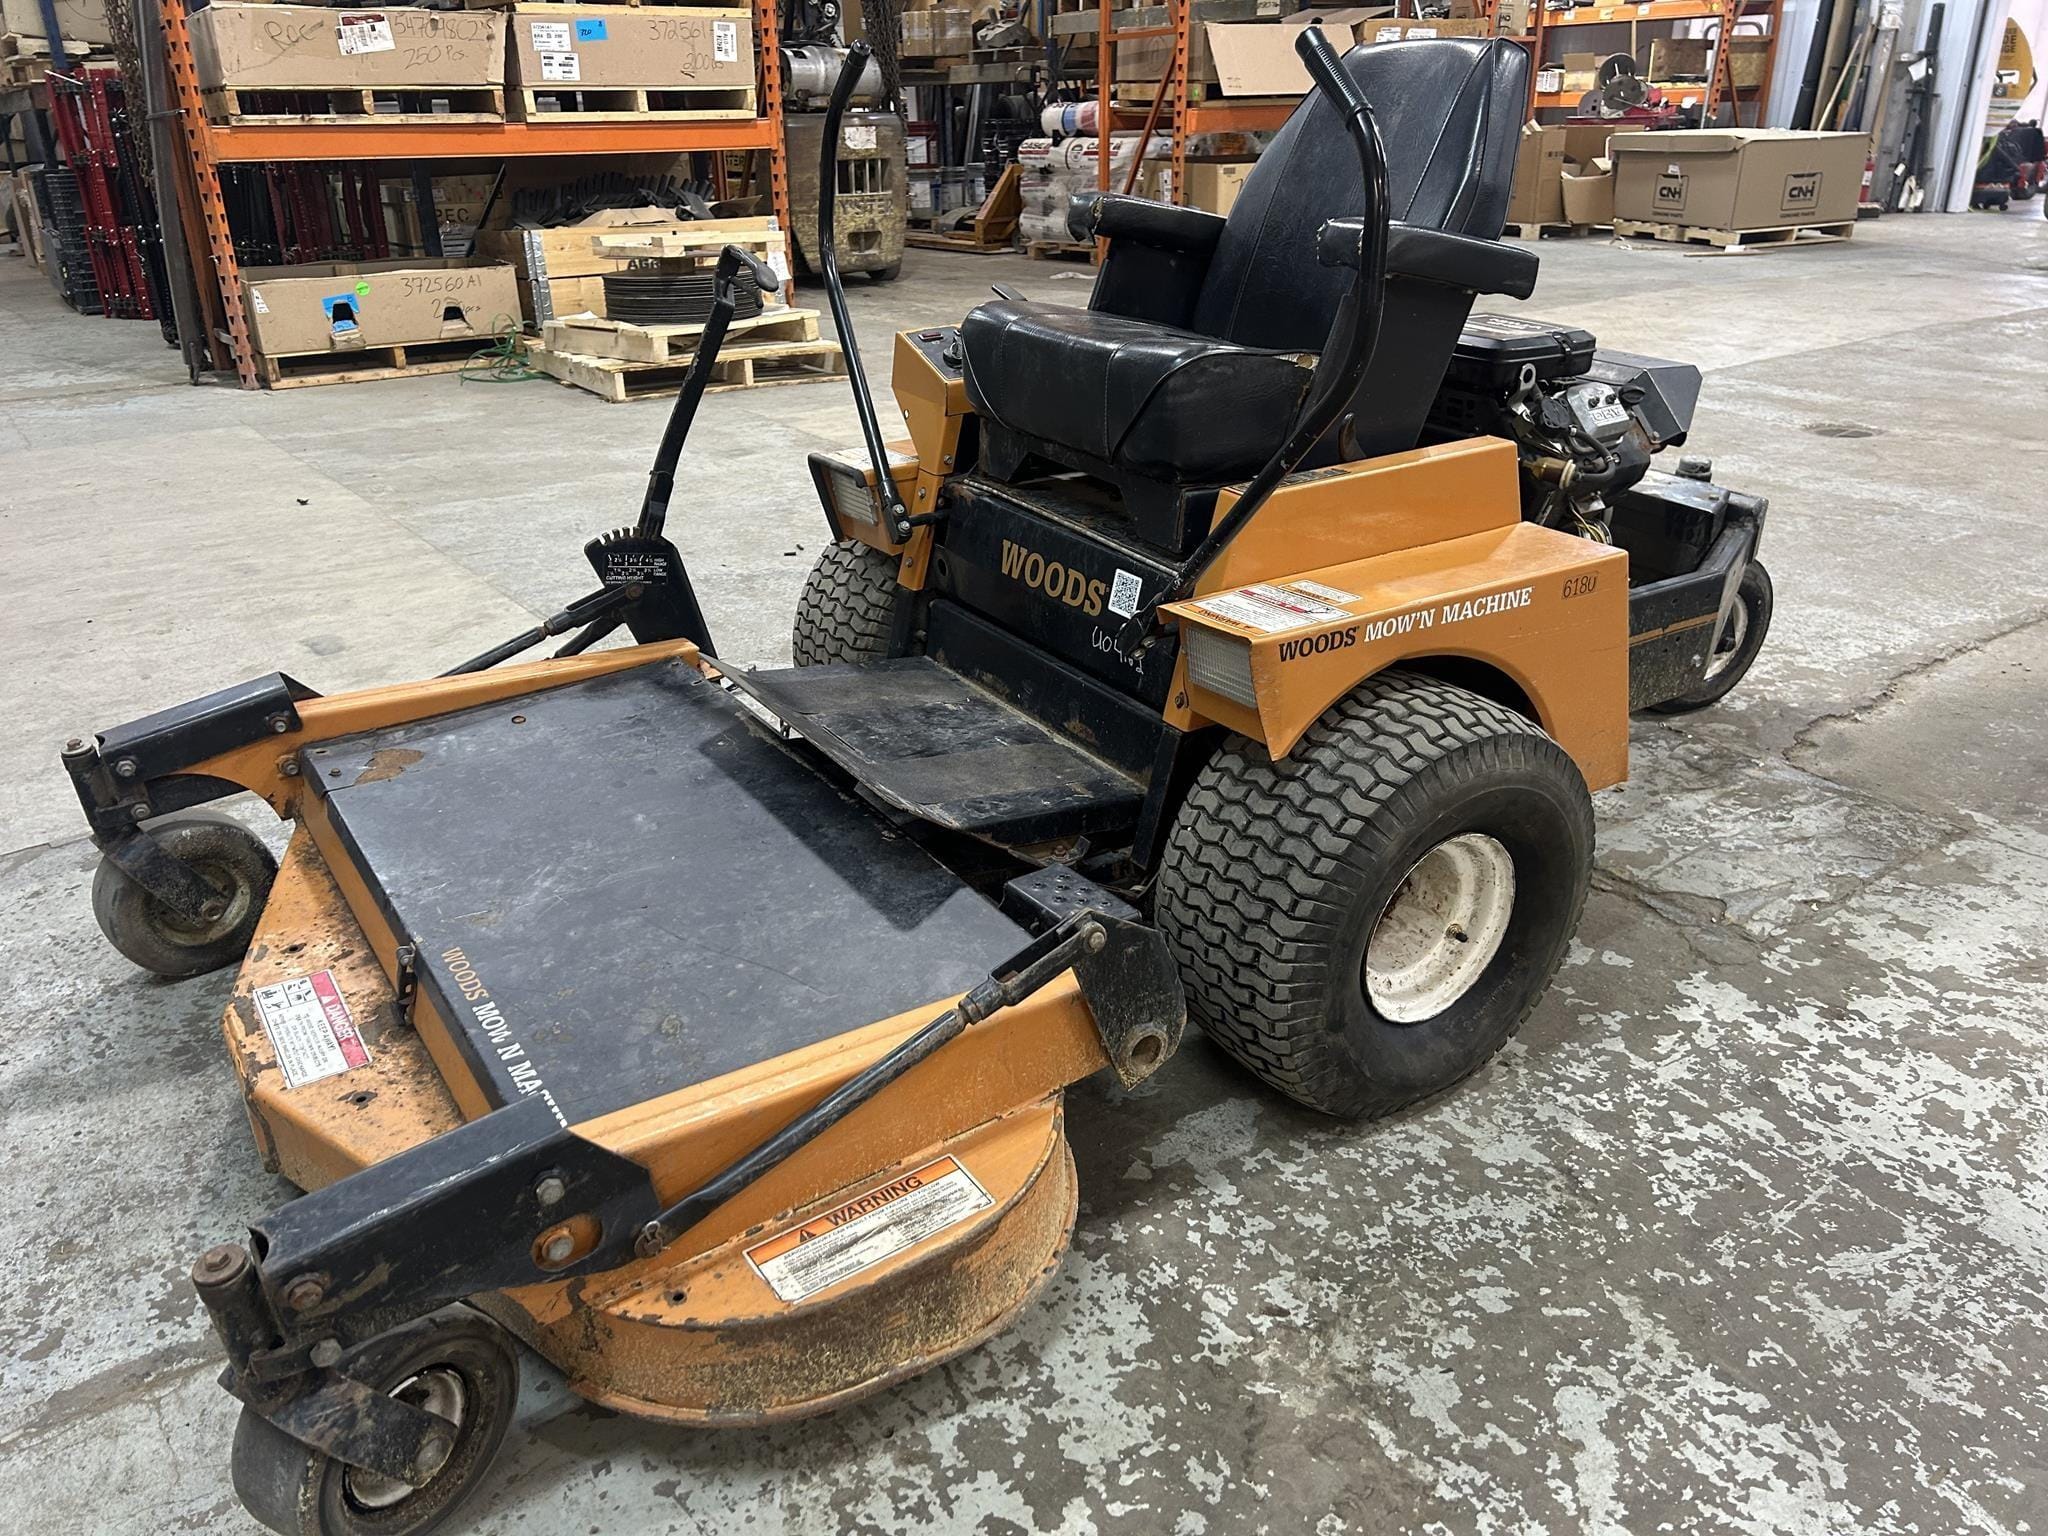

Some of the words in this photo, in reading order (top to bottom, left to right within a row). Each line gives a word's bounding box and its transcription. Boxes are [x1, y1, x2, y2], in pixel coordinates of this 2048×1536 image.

[1001, 538, 1107, 617] WOODS
[1278, 627, 1358, 663] WOODS
[1441, 586, 1533, 625] MACHINE
[441, 947, 489, 1002] WOODS
[324, 1003, 353, 1041] DANGER
[825, 1175, 924, 1227] WARNING
